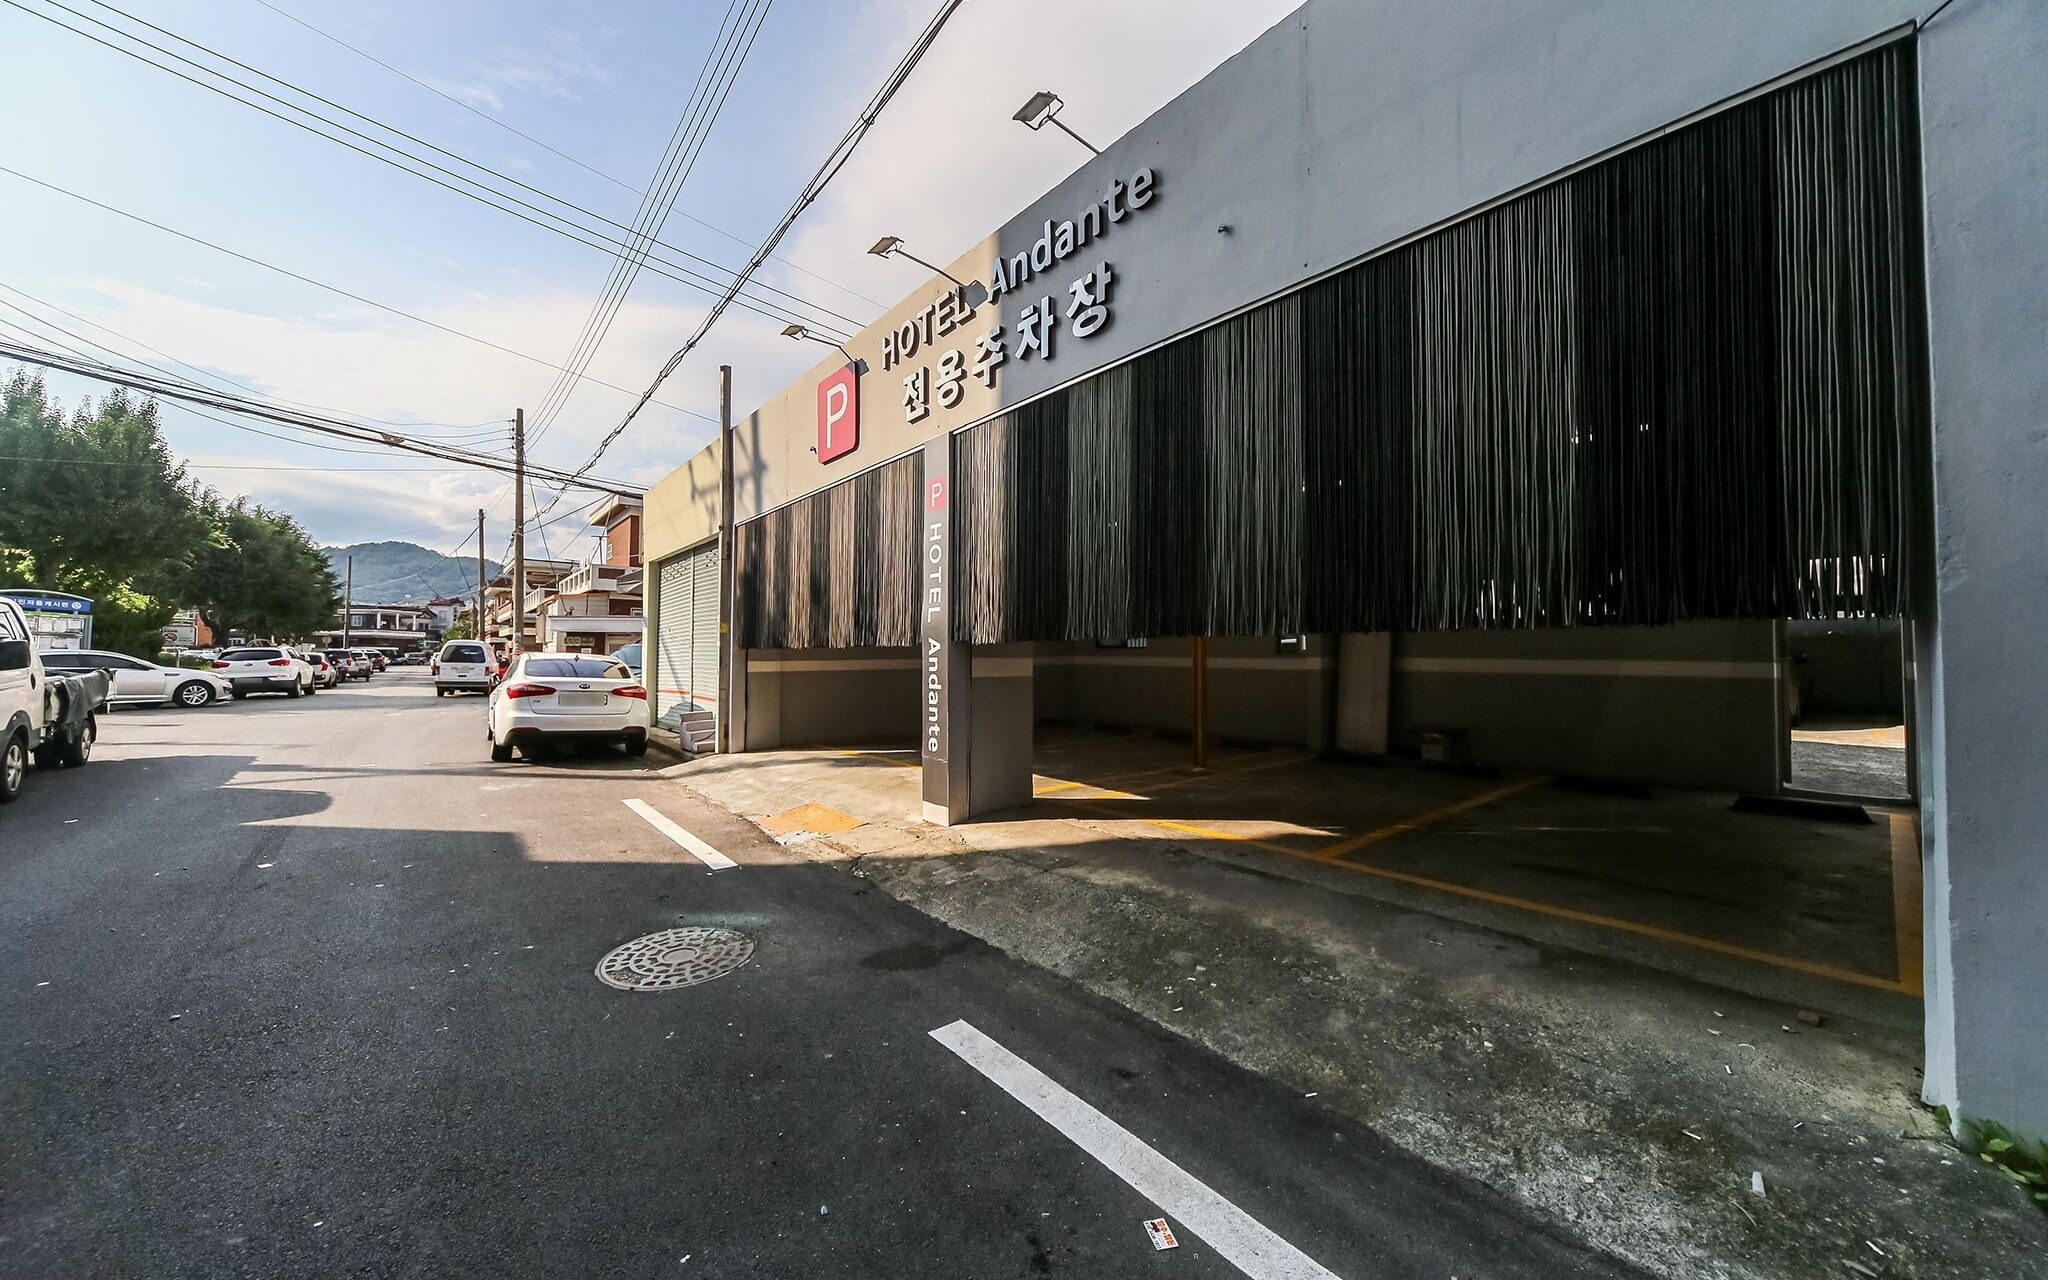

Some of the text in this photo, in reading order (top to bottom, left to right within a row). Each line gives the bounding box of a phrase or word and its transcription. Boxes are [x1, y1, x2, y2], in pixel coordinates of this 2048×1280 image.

[881, 167, 1155, 372] HOTEL Andante
[901, 261, 1112, 425] 전용주차장
[826, 382, 848, 450] P
[928, 482, 943, 753] P HOTEL Andante
